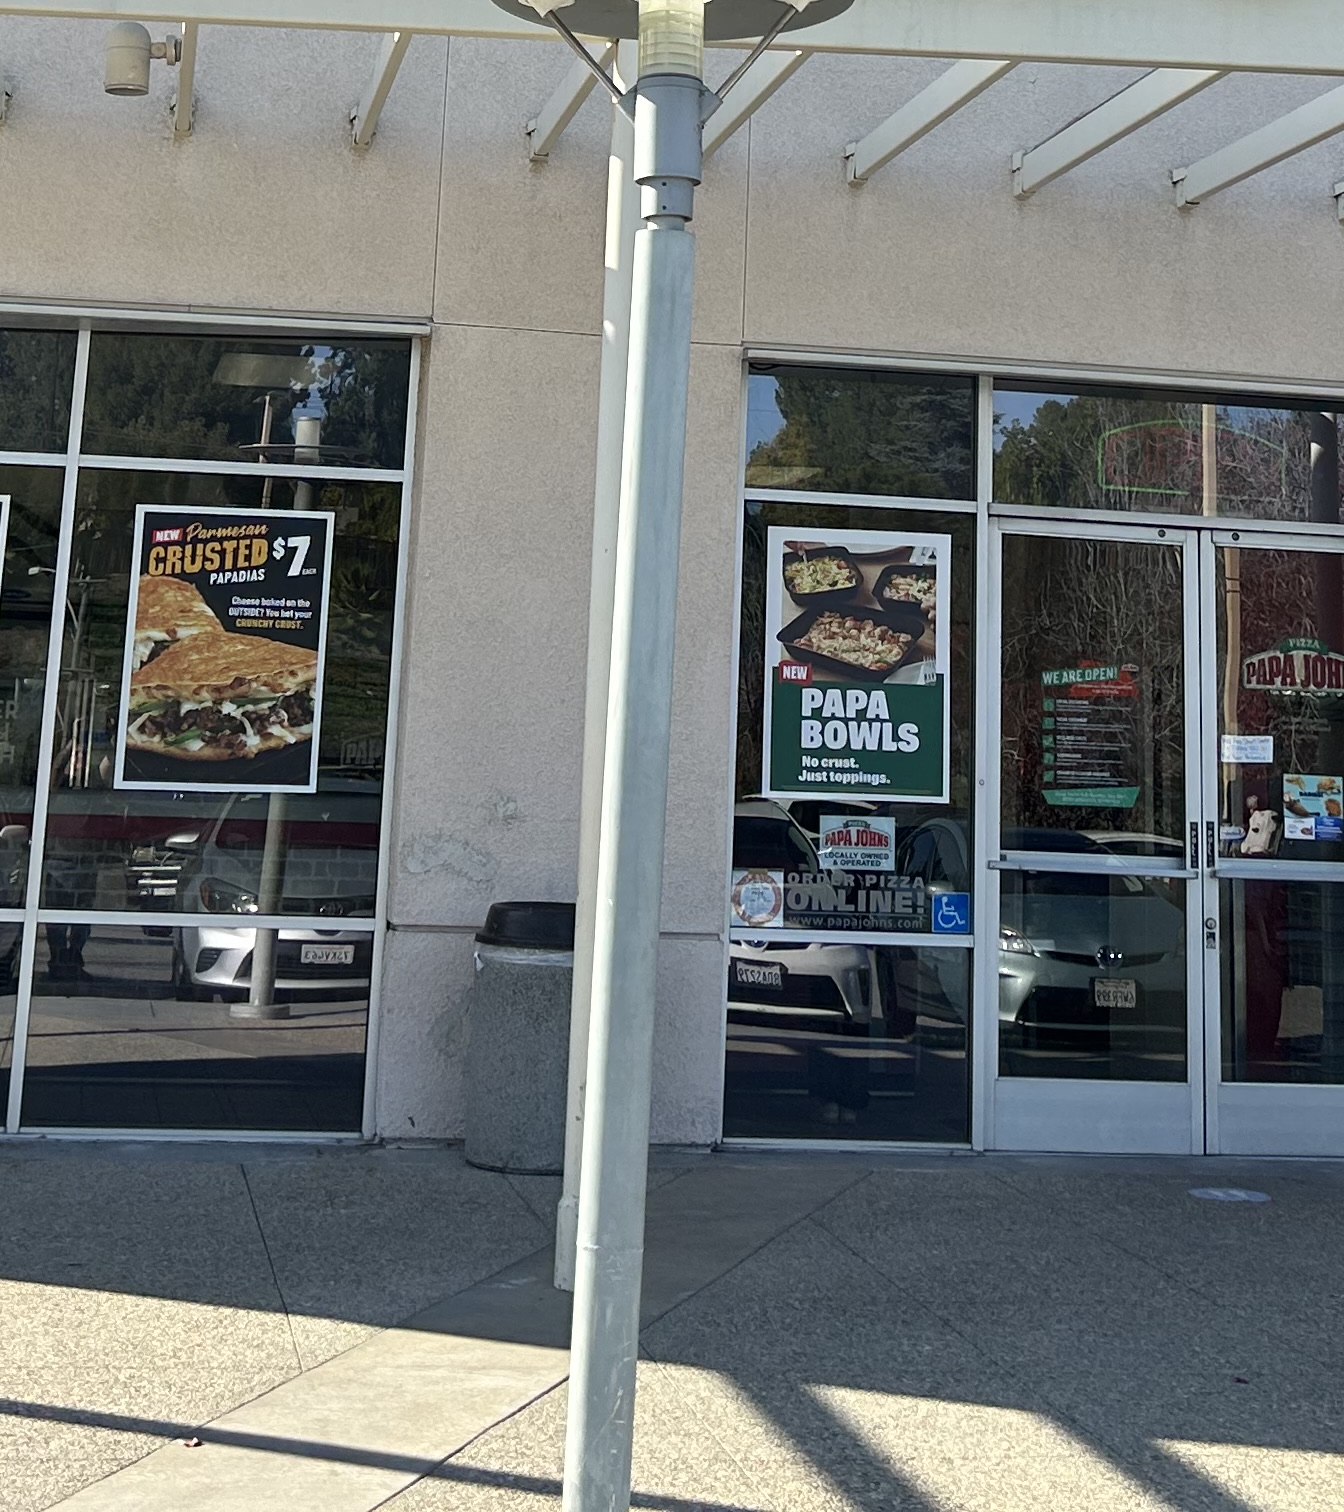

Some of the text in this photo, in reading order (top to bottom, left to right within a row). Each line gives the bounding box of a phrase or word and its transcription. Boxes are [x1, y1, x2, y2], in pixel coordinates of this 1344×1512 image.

[156, 522, 269, 541] NEW Parmesan
[148, 539, 268, 576] CRUSTED
[272, 536, 311, 576] $7
[210, 569, 265, 585] PAPADIAS
[1289, 638, 1320, 649] PIZZA
[782, 665, 807, 680] NEW
[1043, 671, 1059, 684] WE
[1062, 670, 1083, 683] ARE
[1085, 667, 1118, 680] OPEN!
[1246, 654, 1296, 686] PAPA
[802, 688, 890, 720] PAPA
[801, 720, 920, 752] BOWLS
[802, 755, 859, 768] No crust.
[798, 769, 891, 785] Just toppings.
[825, 829, 852, 846] PAPA
[787, 872, 925, 888] ORDER PIZZA
[786, 888, 925, 913] ONLINE!
[789, 915, 923, 929] www.papajohns.com
